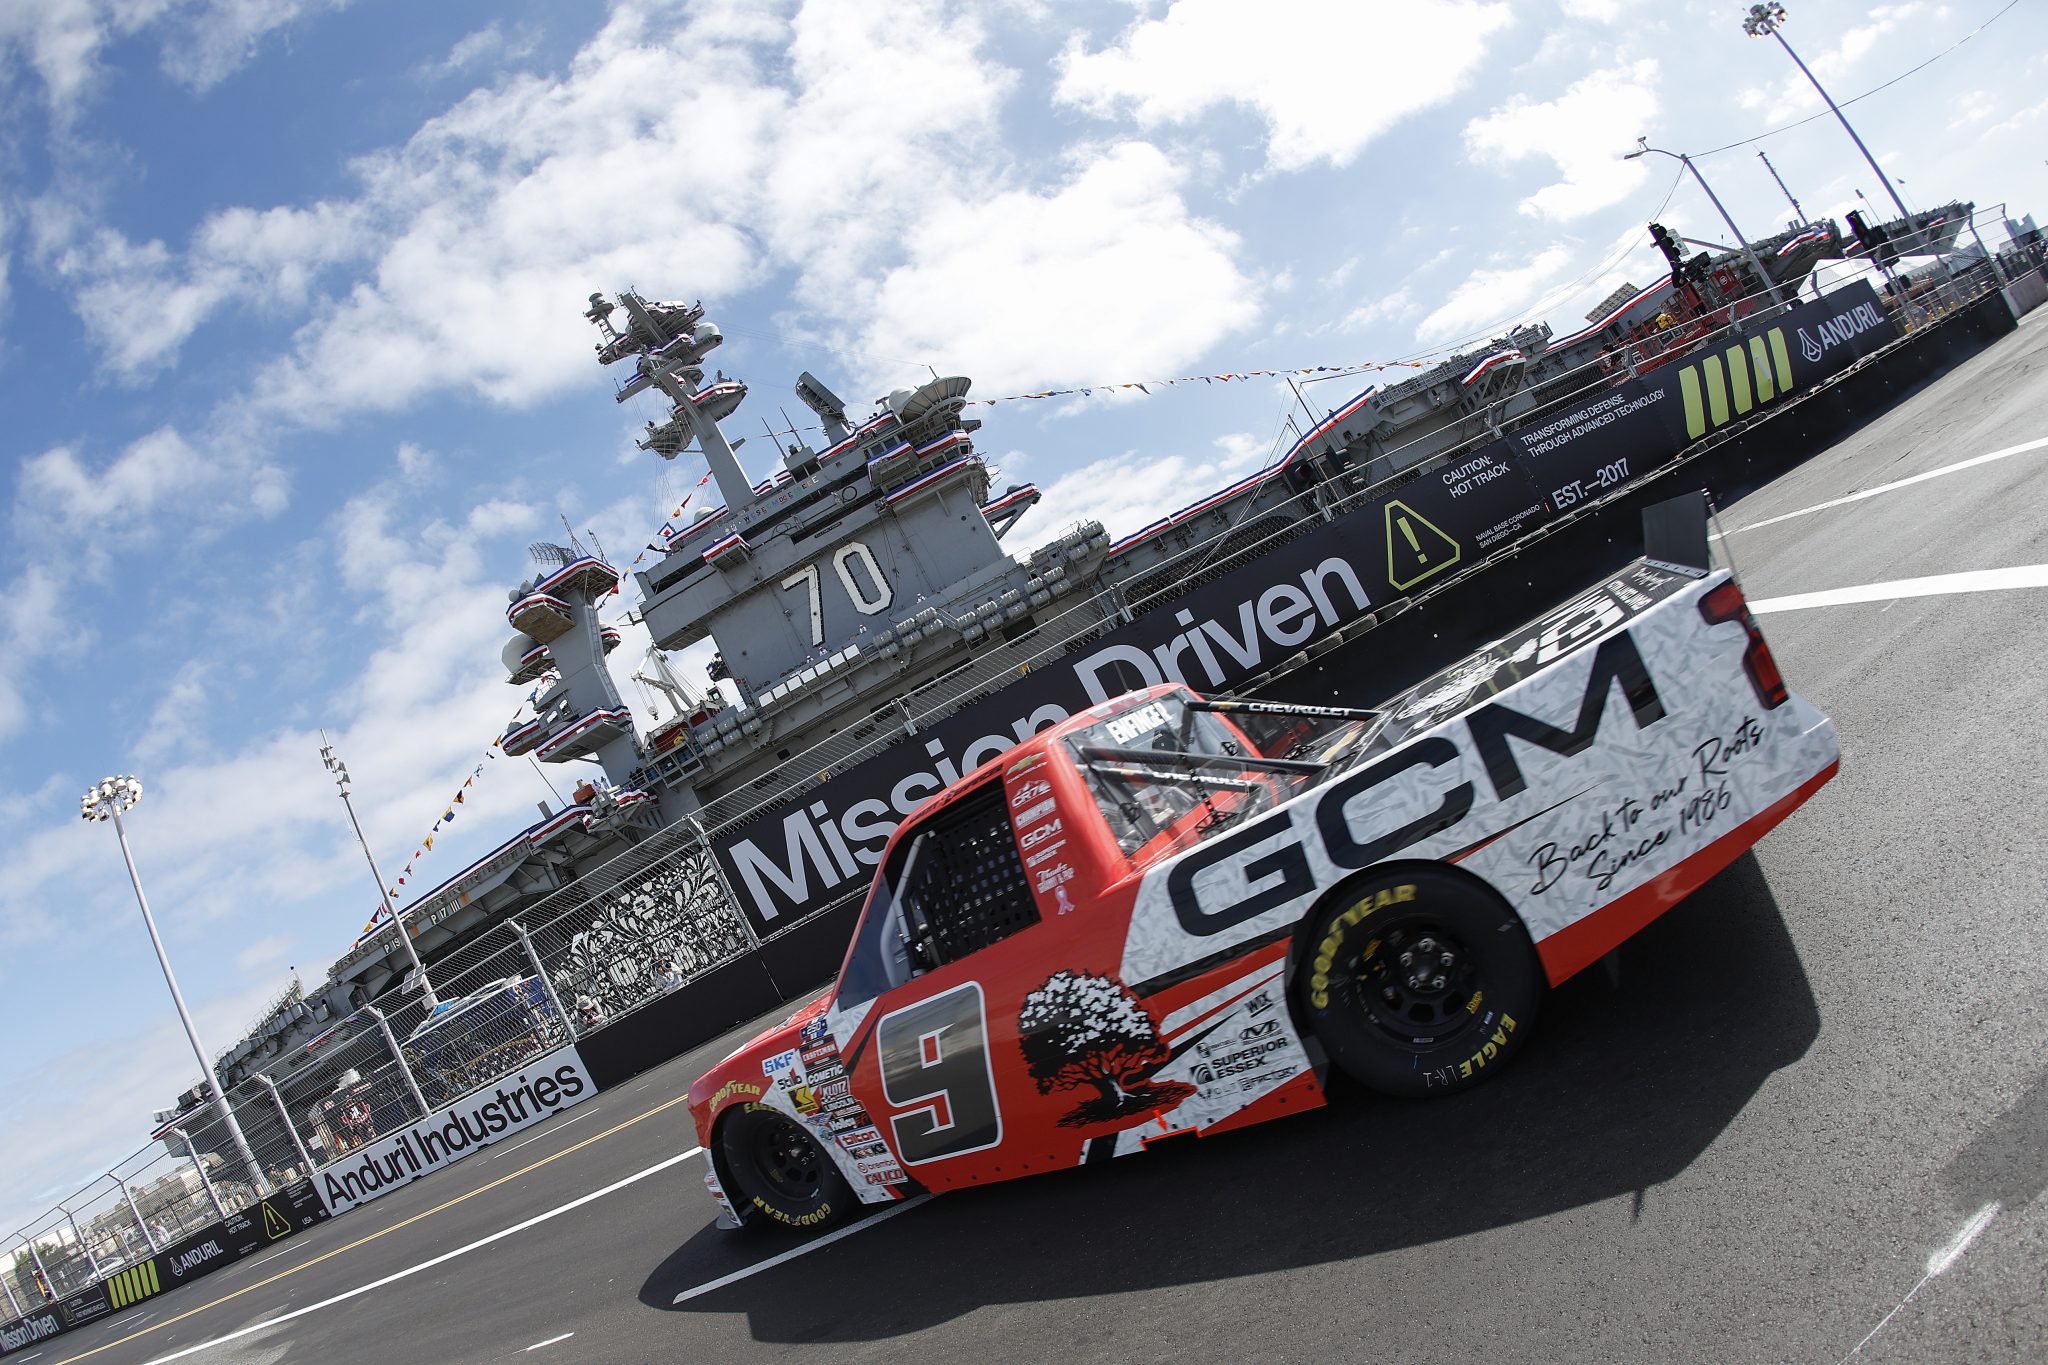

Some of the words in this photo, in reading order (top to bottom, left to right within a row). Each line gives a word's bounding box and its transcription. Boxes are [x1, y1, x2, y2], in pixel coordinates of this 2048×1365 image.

[1820, 301, 1884, 350] ANDURIL
[1520, 409, 1589, 446] TRANSFORMING
[1587, 393, 1625, 417] DEFENSE
[1527, 431, 1573, 458] THROUGH
[1572, 412, 1616, 439] ADVANCED
[1613, 388, 1666, 419] TECHNOLOGY
[1442, 455, 1494, 486] CAUTION:
[1449, 478, 1474, 499] HOT
[1471, 461, 1511, 487] TRACK
[1475, 526, 1496, 542] NAVAL
[1493, 519, 1510, 533] BASE
[1507, 504, 1541, 525] CORONADO
[1479, 536, 1493, 549] SAN
[780, 541, 895, 647] 70
[1073, 556, 1371, 701] Driven
[1249, 702, 1351, 718] CHEVROLET
[1168, 630, 1668, 938] GCM
[1528, 811, 1616, 896] Back
[1615, 797, 1644, 833] to
[1651, 776, 1689, 811] our
[1691, 718, 1765, 786] Roots
[1020, 818, 1063, 849] GCM
[1587, 829, 1673, 891] Since
[1679, 779, 1733, 835] 1986
[1310, 884, 1418, 1010] GOODYEAR
[1244, 989, 1273, 1015] WIX
[1211, 1037, 1288, 1069] SUPERIOR
[1459, 1011, 1518, 1080] EAGLE
[763, 1051, 795, 1074] SKF
[807, 1064, 844, 1085] COMETIC
[876, 980, 1004, 1167] 9
[1216, 1055, 1268, 1079] ESSEX
[709, 1079, 761, 1113] GOODYEAR
[822, 1080, 848, 1098] KLOTZ
[824, 1096, 856, 1112] LINCOLN
[324, 1139, 423, 1210] Anduril
[412, 1064, 584, 1166] Industries
[829, 1116, 857, 1132] Holley
[842, 1130, 879, 1146] tilton
[865, 1168, 904, 1185] CALICO
[866, 1159, 897, 1170] brembo
[302, 1215, 314, 1226] USA
[752, 1194, 833, 1227] GOODYEAR
[180, 1239, 224, 1271] ANDURIL
[22, 1314, 60, 1341] Driven
